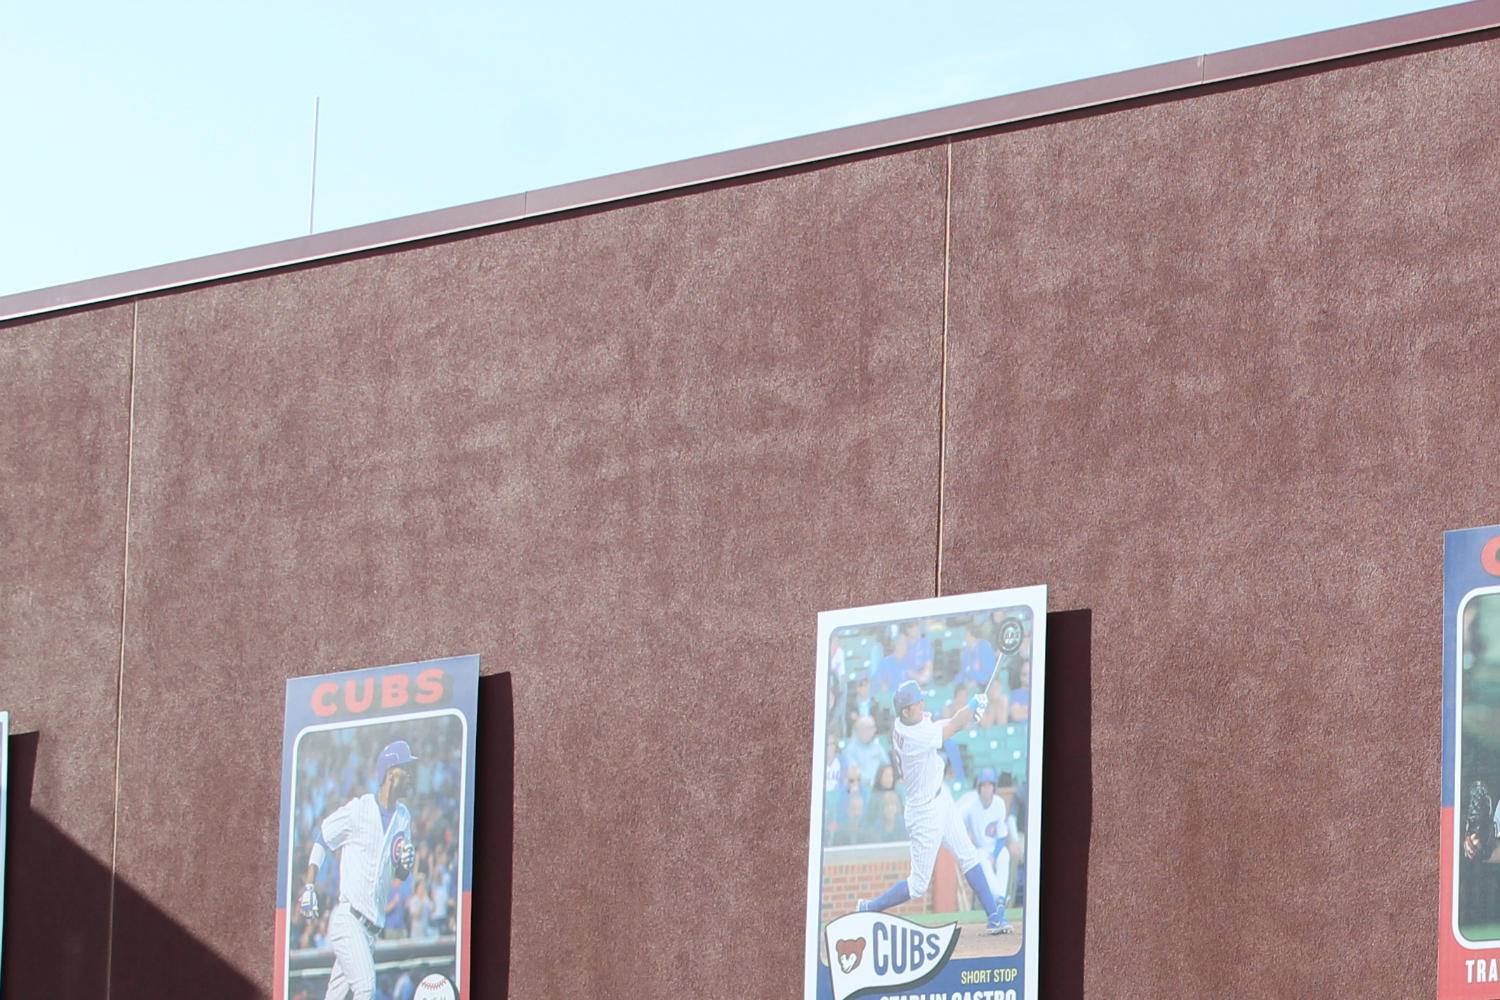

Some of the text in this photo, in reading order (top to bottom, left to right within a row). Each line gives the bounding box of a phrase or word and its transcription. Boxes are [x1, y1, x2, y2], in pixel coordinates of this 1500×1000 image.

[310, 667, 446, 718] CUBS
[873, 921, 941, 976] CUBS
[961, 968, 1018, 984] SHORT STOP
